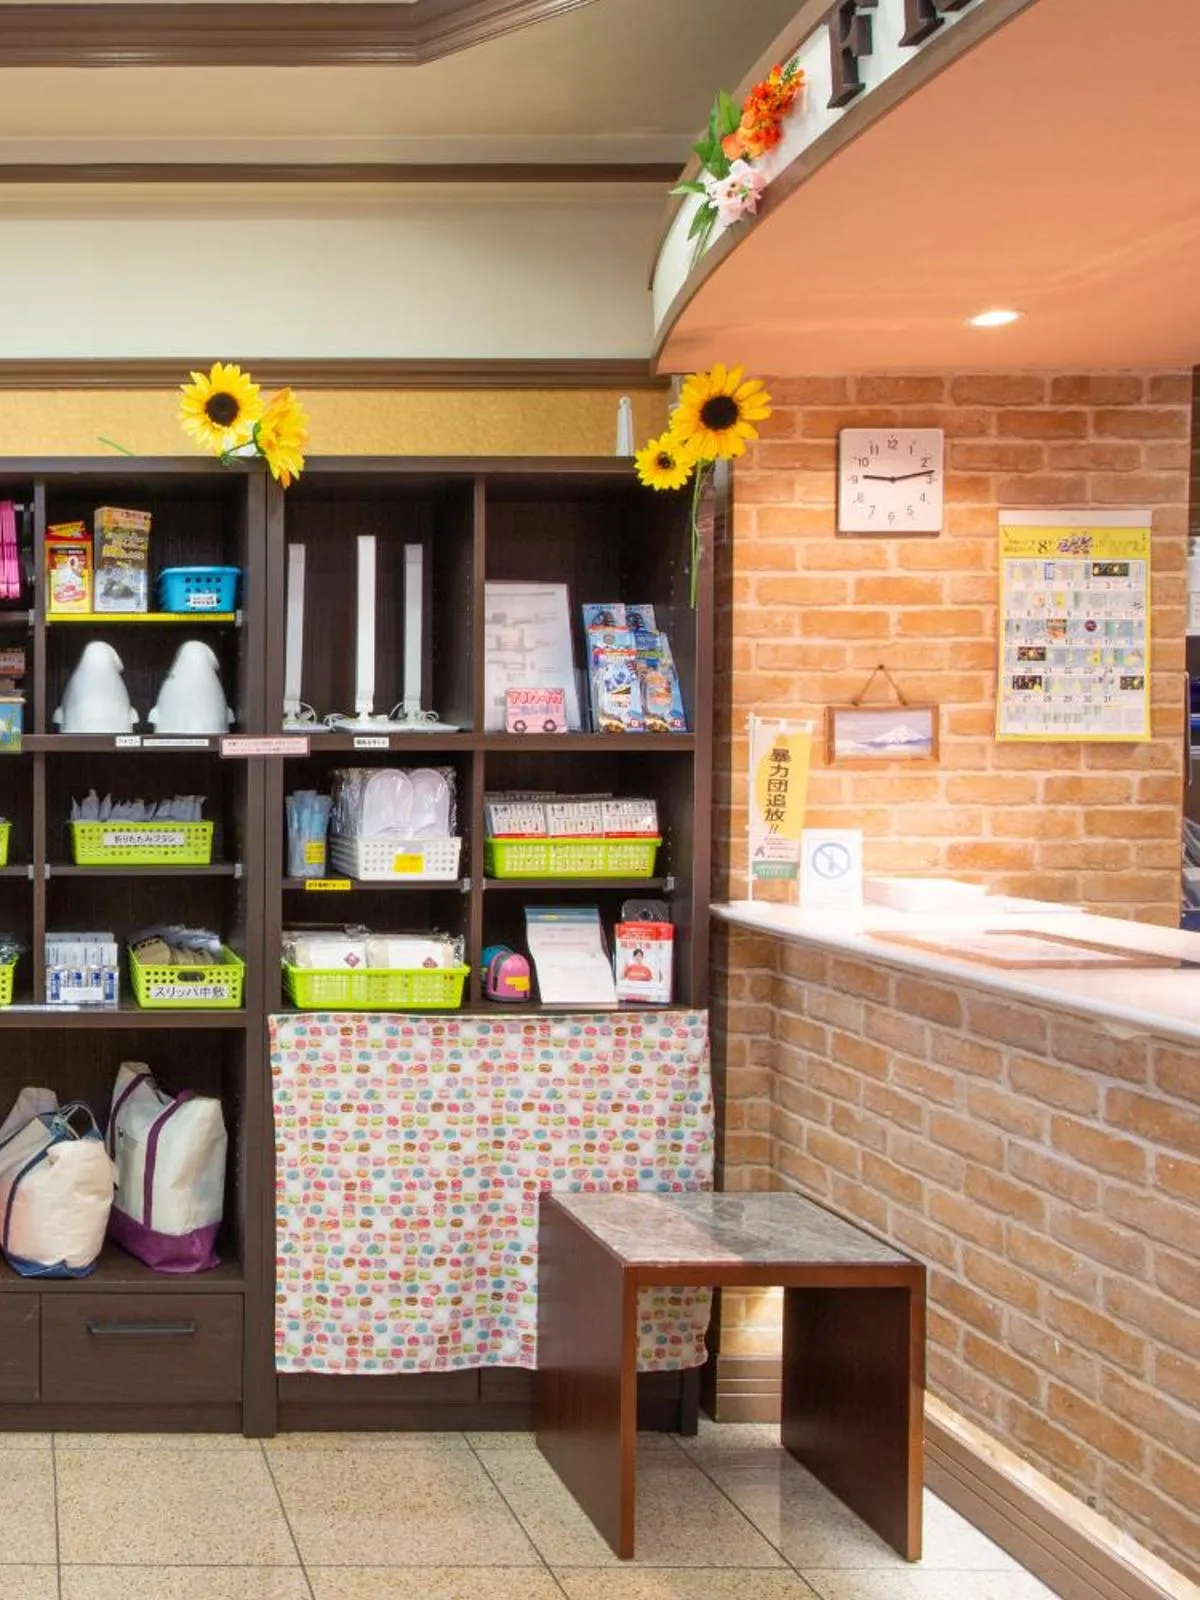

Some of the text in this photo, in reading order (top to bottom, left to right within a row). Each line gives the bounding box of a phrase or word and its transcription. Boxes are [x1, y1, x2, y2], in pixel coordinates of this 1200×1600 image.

[870, 443, 880, 455] 11
[888, 439, 898, 450] 12
[858, 456, 870, 467] 10
